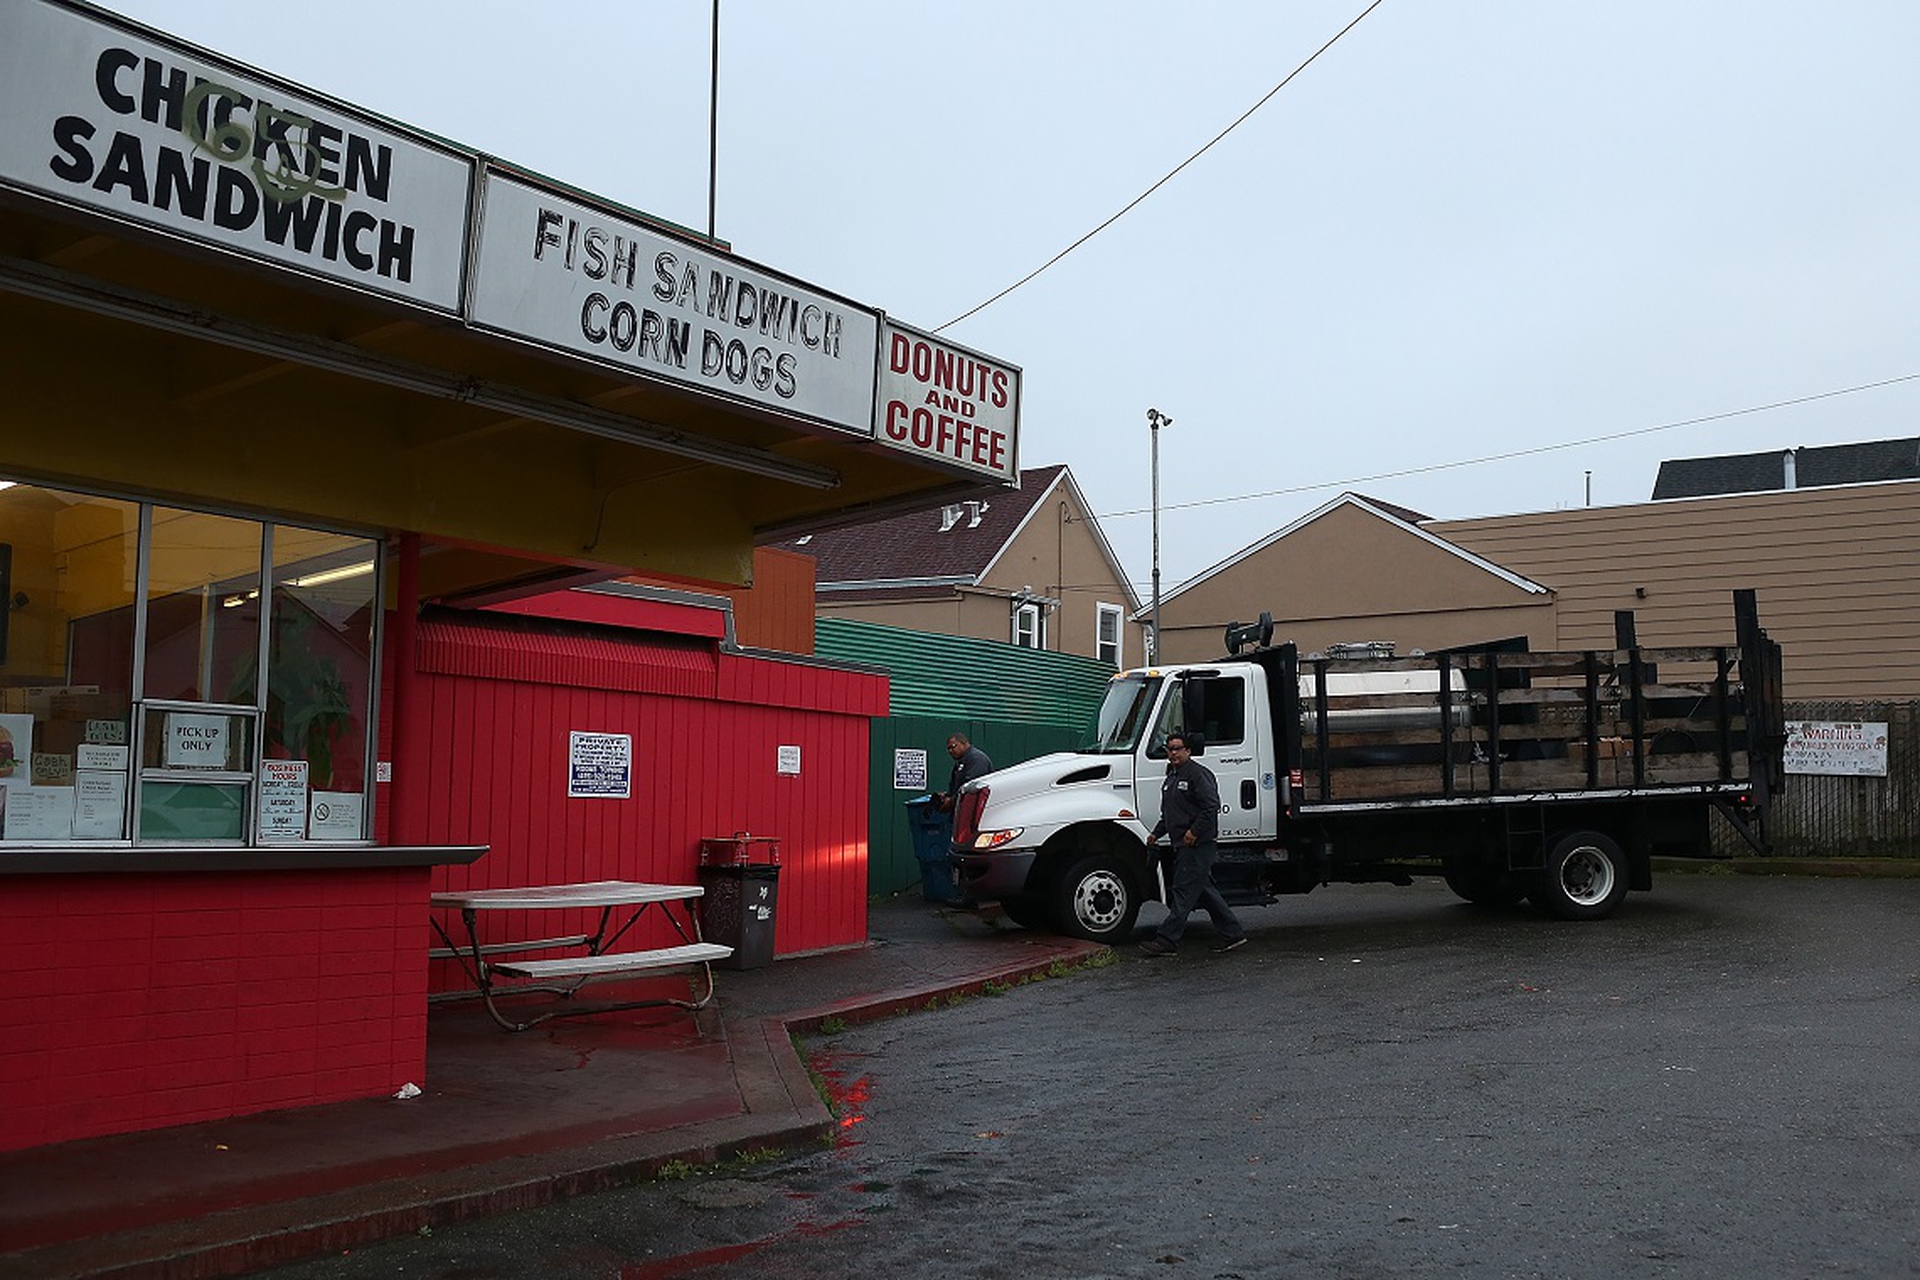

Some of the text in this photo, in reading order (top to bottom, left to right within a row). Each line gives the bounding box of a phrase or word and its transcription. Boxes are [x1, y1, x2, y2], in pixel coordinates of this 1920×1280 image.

[95, 48, 393, 202] CHICKEN
[49, 115, 415, 284] SANDWICH
[533, 207, 844, 358] FISH SANDWICH
[580, 292, 797, 399] CORN DOGS
[890, 331, 1008, 408] DONUTS
[885, 400, 1006, 471] COFFEE
[924, 389, 976, 418] AND
[176, 726, 219, 739] PICK UP
[181, 740, 212, 751] ONLY
[575, 743, 626, 751] PROPERTY
[578, 737, 622, 745] PRIVATE
